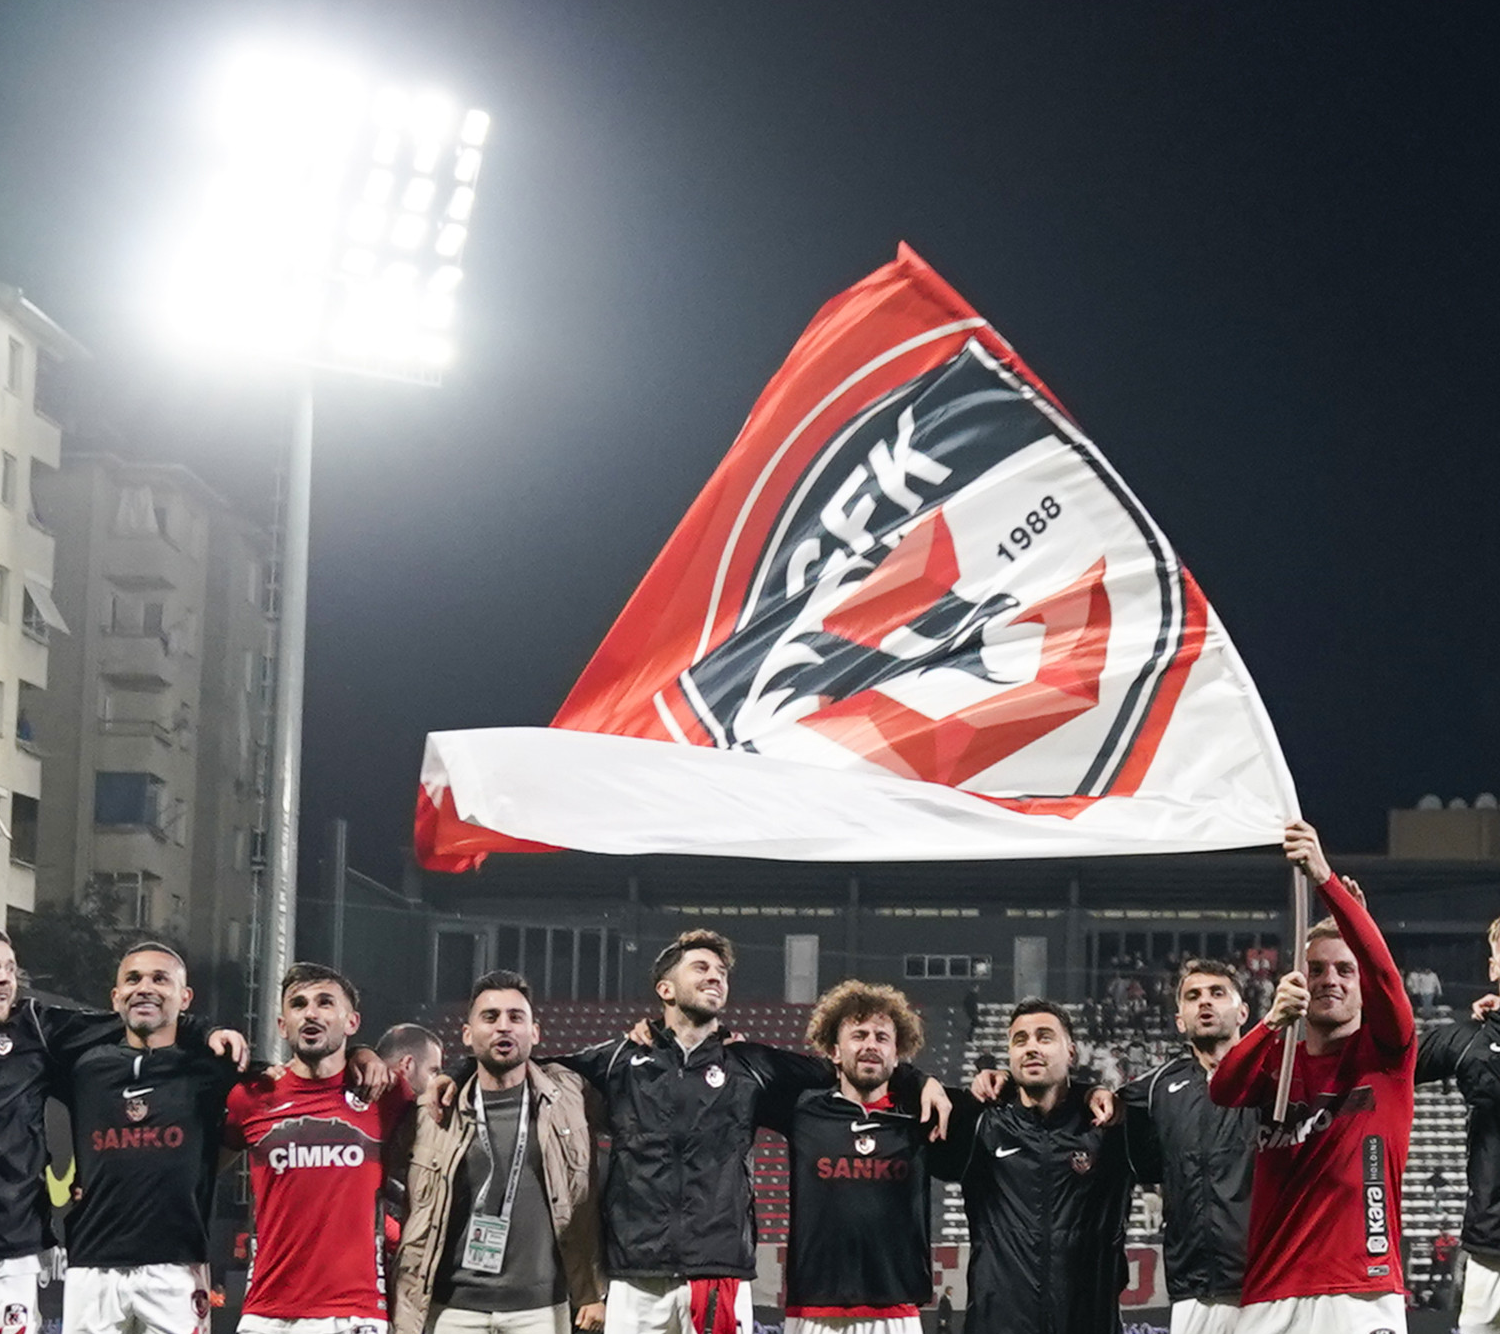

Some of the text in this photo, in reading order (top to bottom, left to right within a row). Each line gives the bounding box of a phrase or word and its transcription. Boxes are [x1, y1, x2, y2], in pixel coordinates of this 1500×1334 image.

[997, 495, 1062, 562] 1988
[92, 1126, 184, 1151] SANKO
[269, 1142, 365, 1174] ÇİMKO
[817, 1157, 908, 1180] SANKO
[1369, 1138, 1378, 1180] HOLDING
